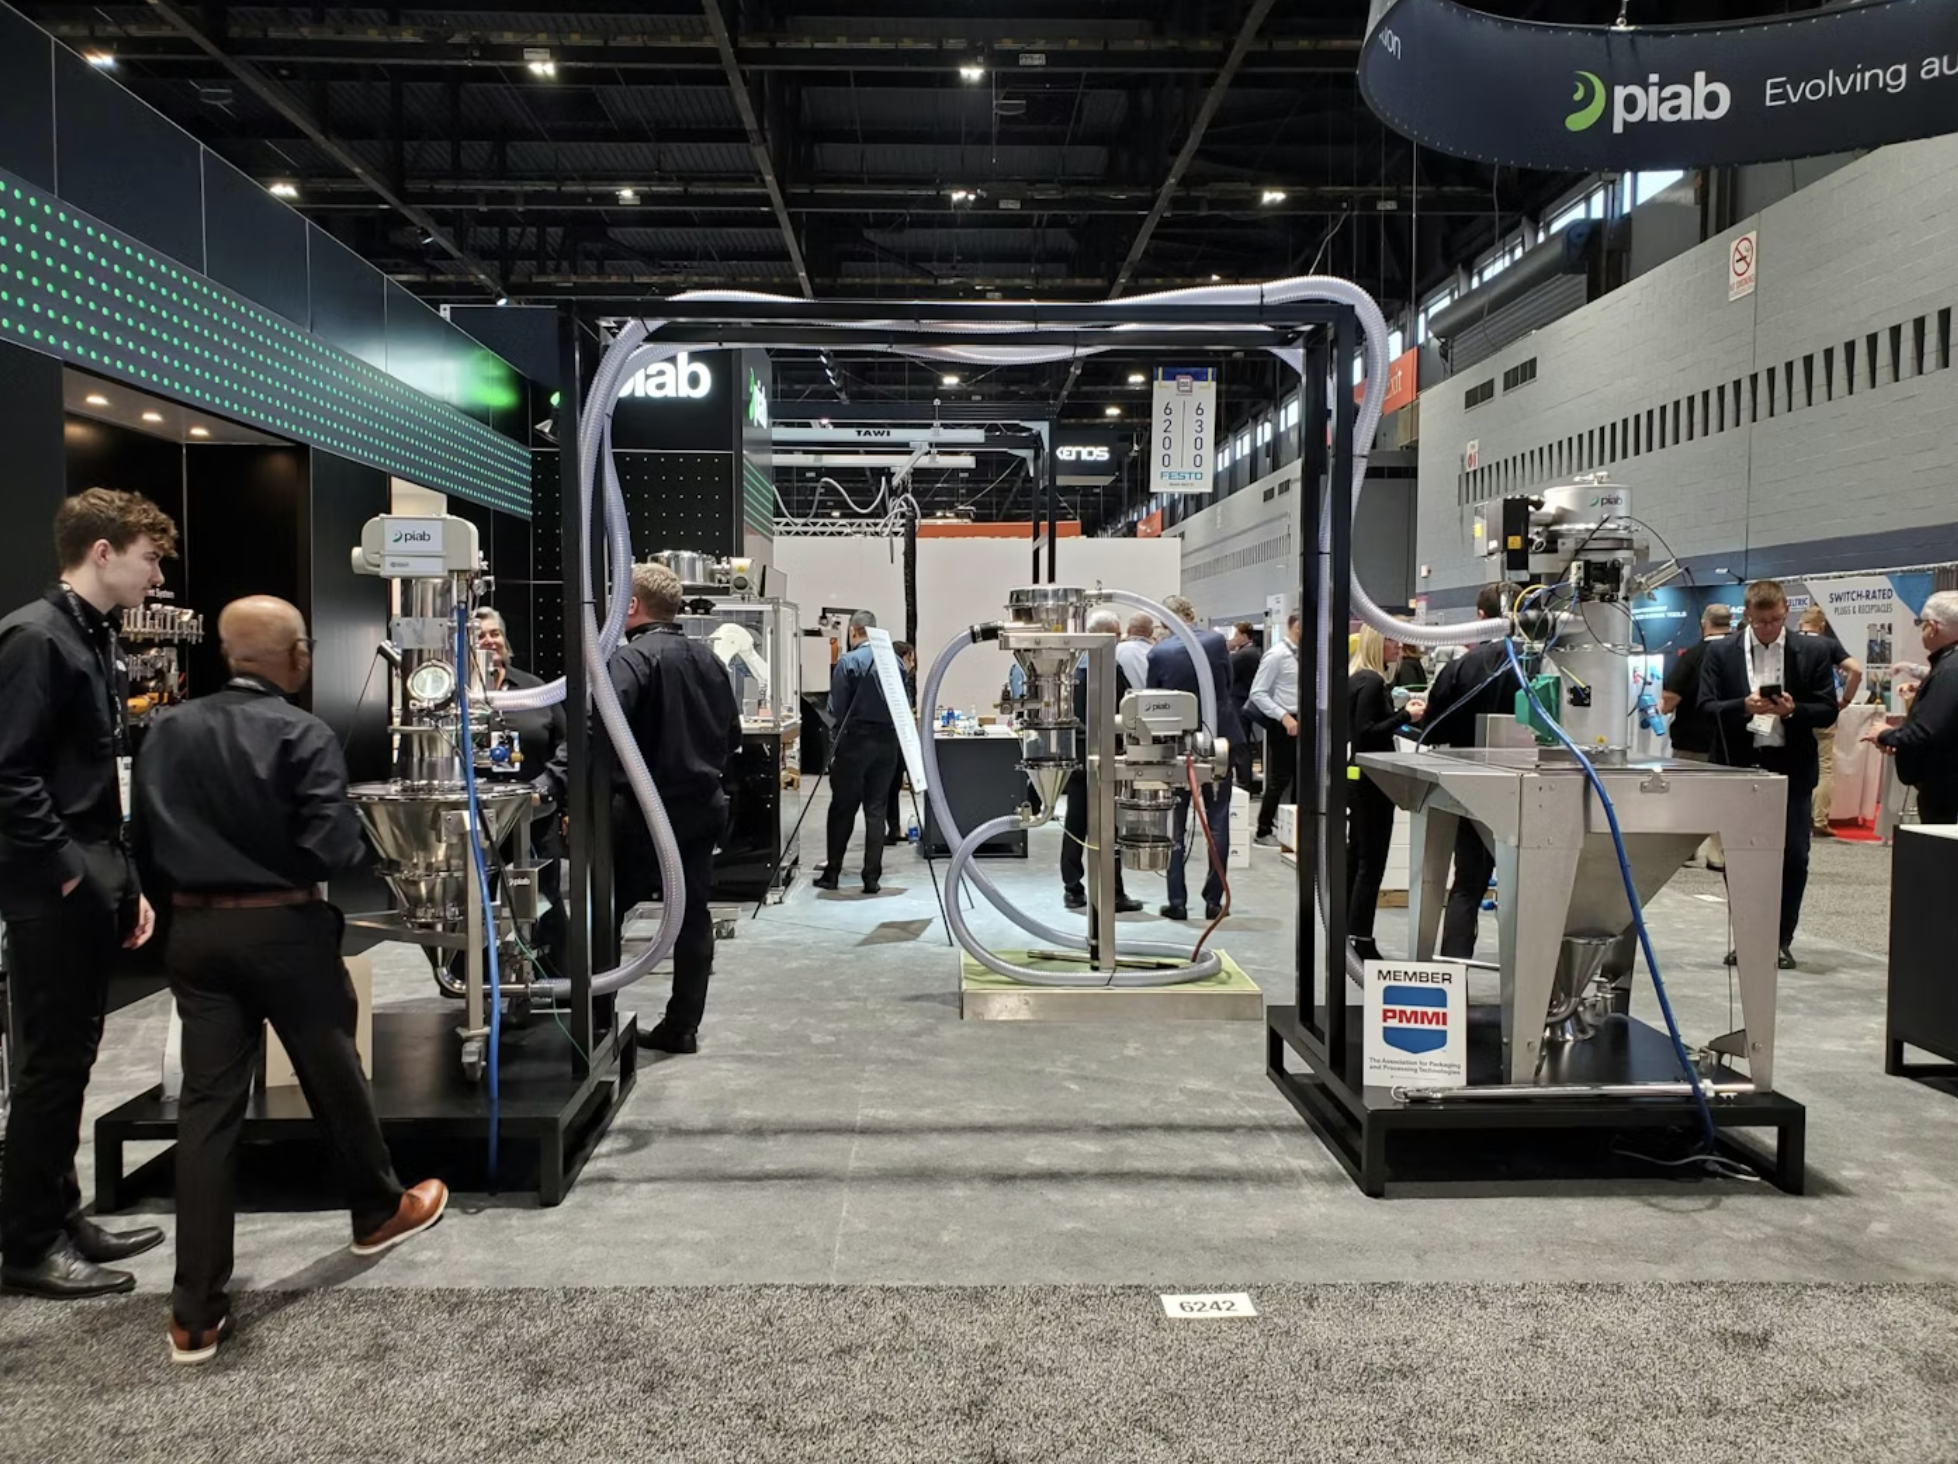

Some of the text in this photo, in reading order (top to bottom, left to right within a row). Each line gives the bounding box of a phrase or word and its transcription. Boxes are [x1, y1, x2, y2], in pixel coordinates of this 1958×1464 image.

[1765, 62, 1907, 106] Evolving
[1612, 71, 1731, 133] piab
[618, 352, 712, 398] iab
[1160, 471, 1203, 480] FESTO
[1601, 494, 1623, 507] piab
[404, 531, 431, 543] piab
[1829, 588, 1893, 604] SWITCH-RATED
[1834, 605, 1851, 616] PLUGS
[1858, 603, 1893, 614] RECEPTACLES
[1152, 702, 1171, 711] piab
[1377, 969, 1452, 984] MEMBER
[1382, 1008, 1447, 1026] PMMI
[1382, 1058, 1417, 1066] Association
[1429, 1061, 1461, 1070] Packaging
[1383, 1064, 1418, 1073] Processing
[1420, 1066, 1461, 1076] Technologies
[1178, 1300, 1239, 1313] 6242
